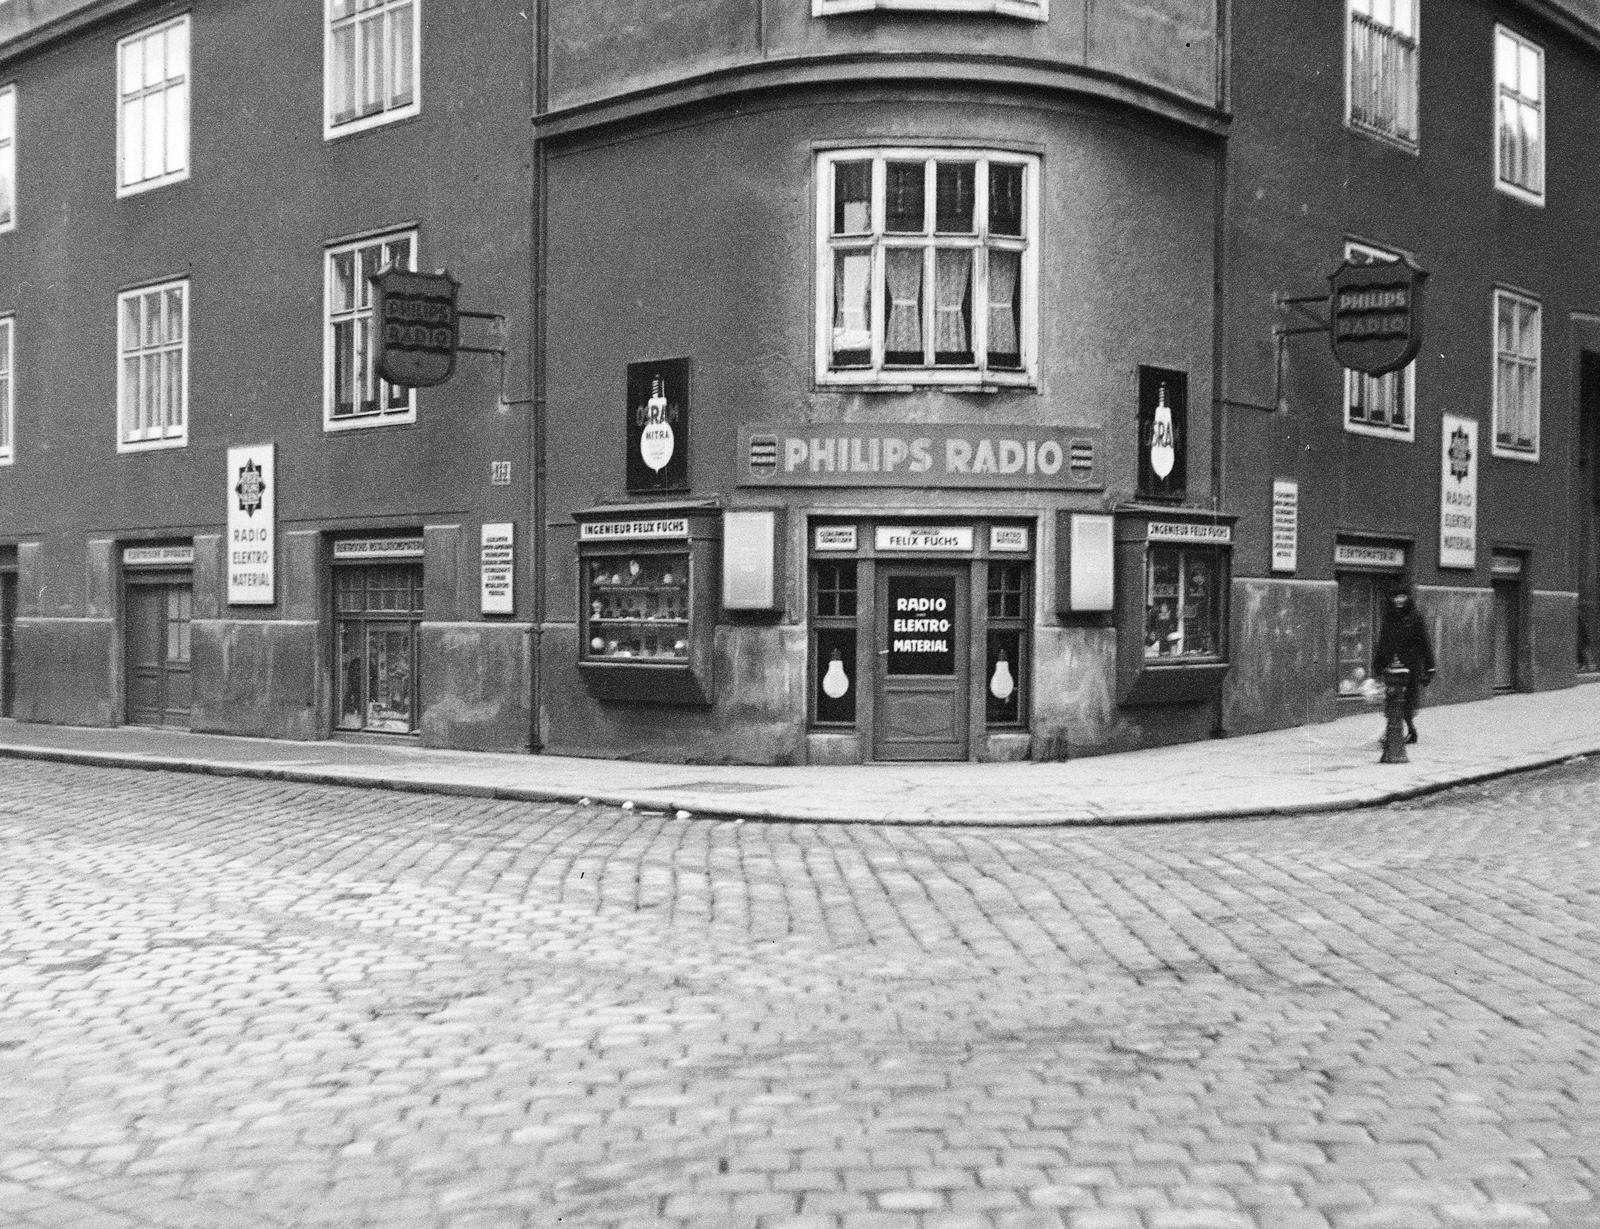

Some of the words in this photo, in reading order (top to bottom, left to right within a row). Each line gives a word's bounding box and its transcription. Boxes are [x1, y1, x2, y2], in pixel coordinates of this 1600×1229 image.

[1340, 290, 1406, 310] PHILIPS
[387, 299, 450, 322] PHILIPS
[1340, 316, 1403, 335] RADIO
[387, 324, 452, 347] RADIO
[785, 438, 933, 473] PHILIPS
[946, 439, 1063, 475] RADIO
[1446, 491, 1472, 507] RADIO
[233, 528, 268, 542] RADIO
[584, 524, 631, 535] INGENIEUR
[633, 523, 655, 533] FELIX
[657, 521, 684, 532] FUCHS
[1150, 523, 1188, 535] INGENIEUR
[889, 536, 919, 546] FELIX
[924, 536, 959, 546] FUCHS
[231, 572, 270, 587] MATERIAL
[897, 597, 947, 612] RADIO
[893, 639, 949, 652] MATERIAL
